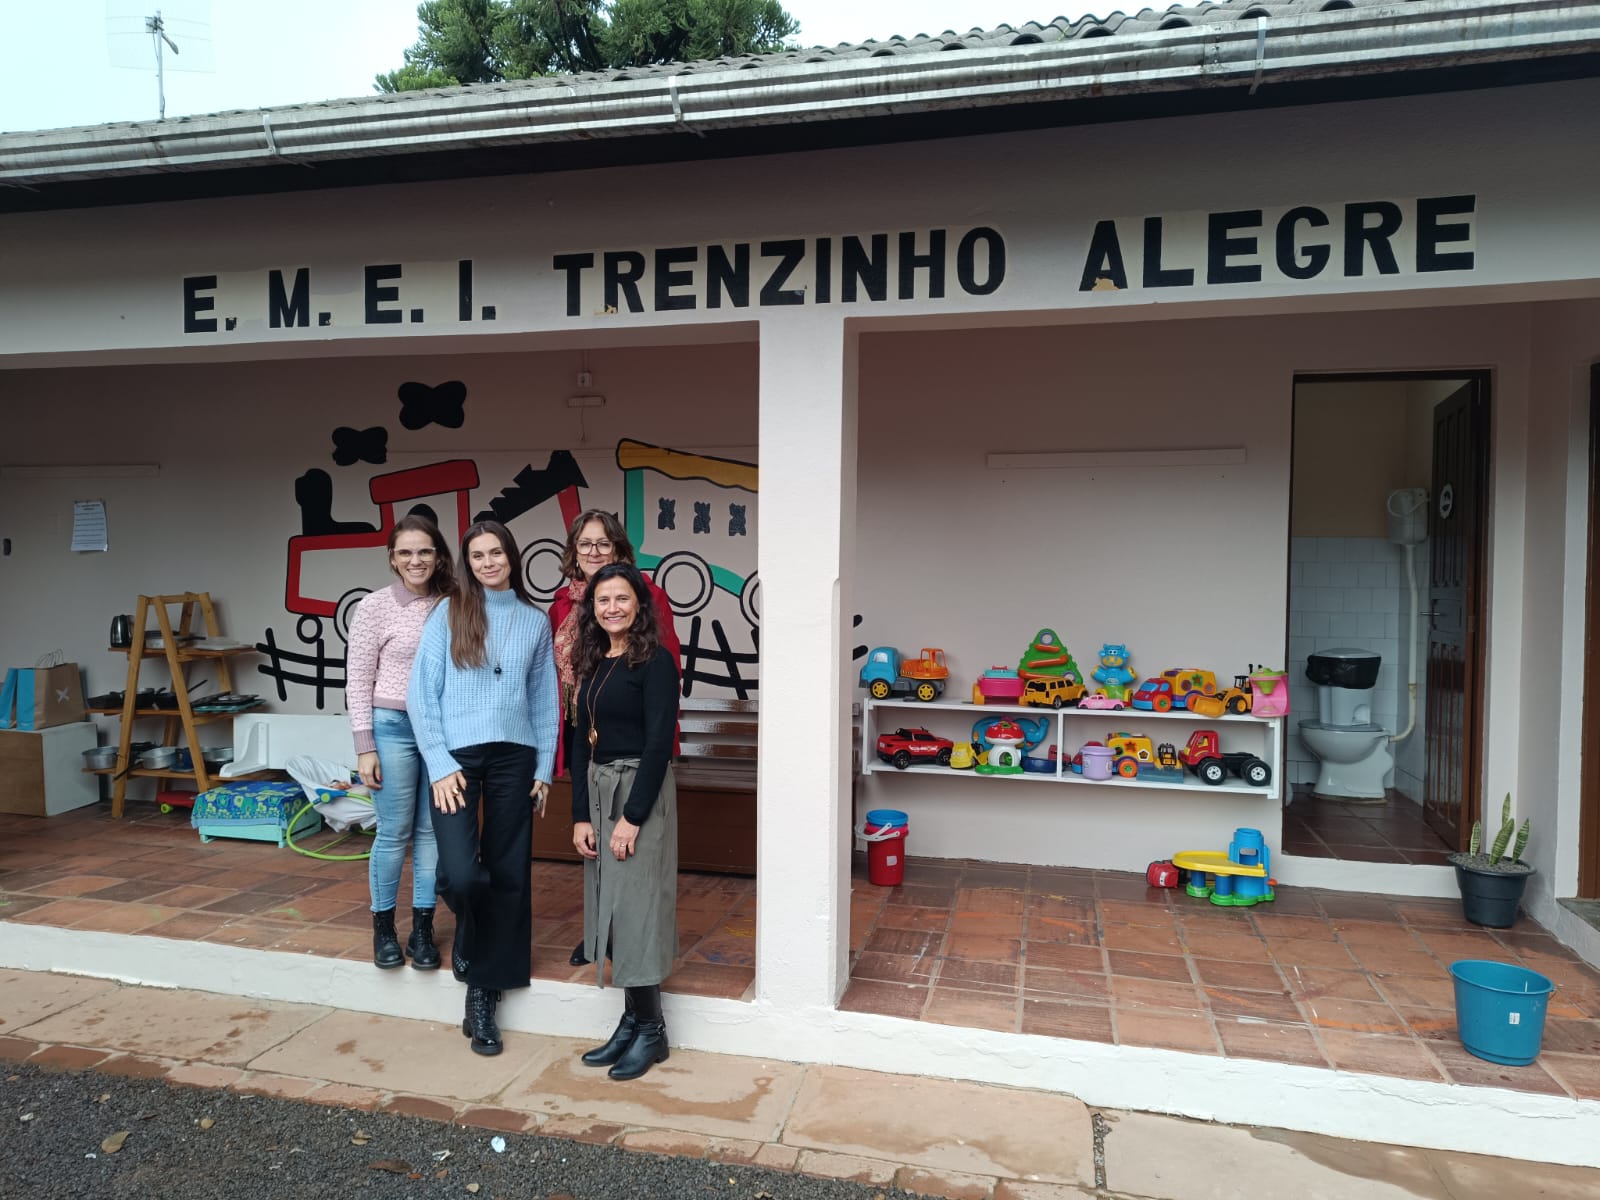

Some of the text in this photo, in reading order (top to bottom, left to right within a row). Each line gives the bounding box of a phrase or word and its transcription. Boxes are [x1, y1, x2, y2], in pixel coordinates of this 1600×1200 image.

[184, 194, 1476, 333] E. M. E. I. TRENZINHO ALEGRE
